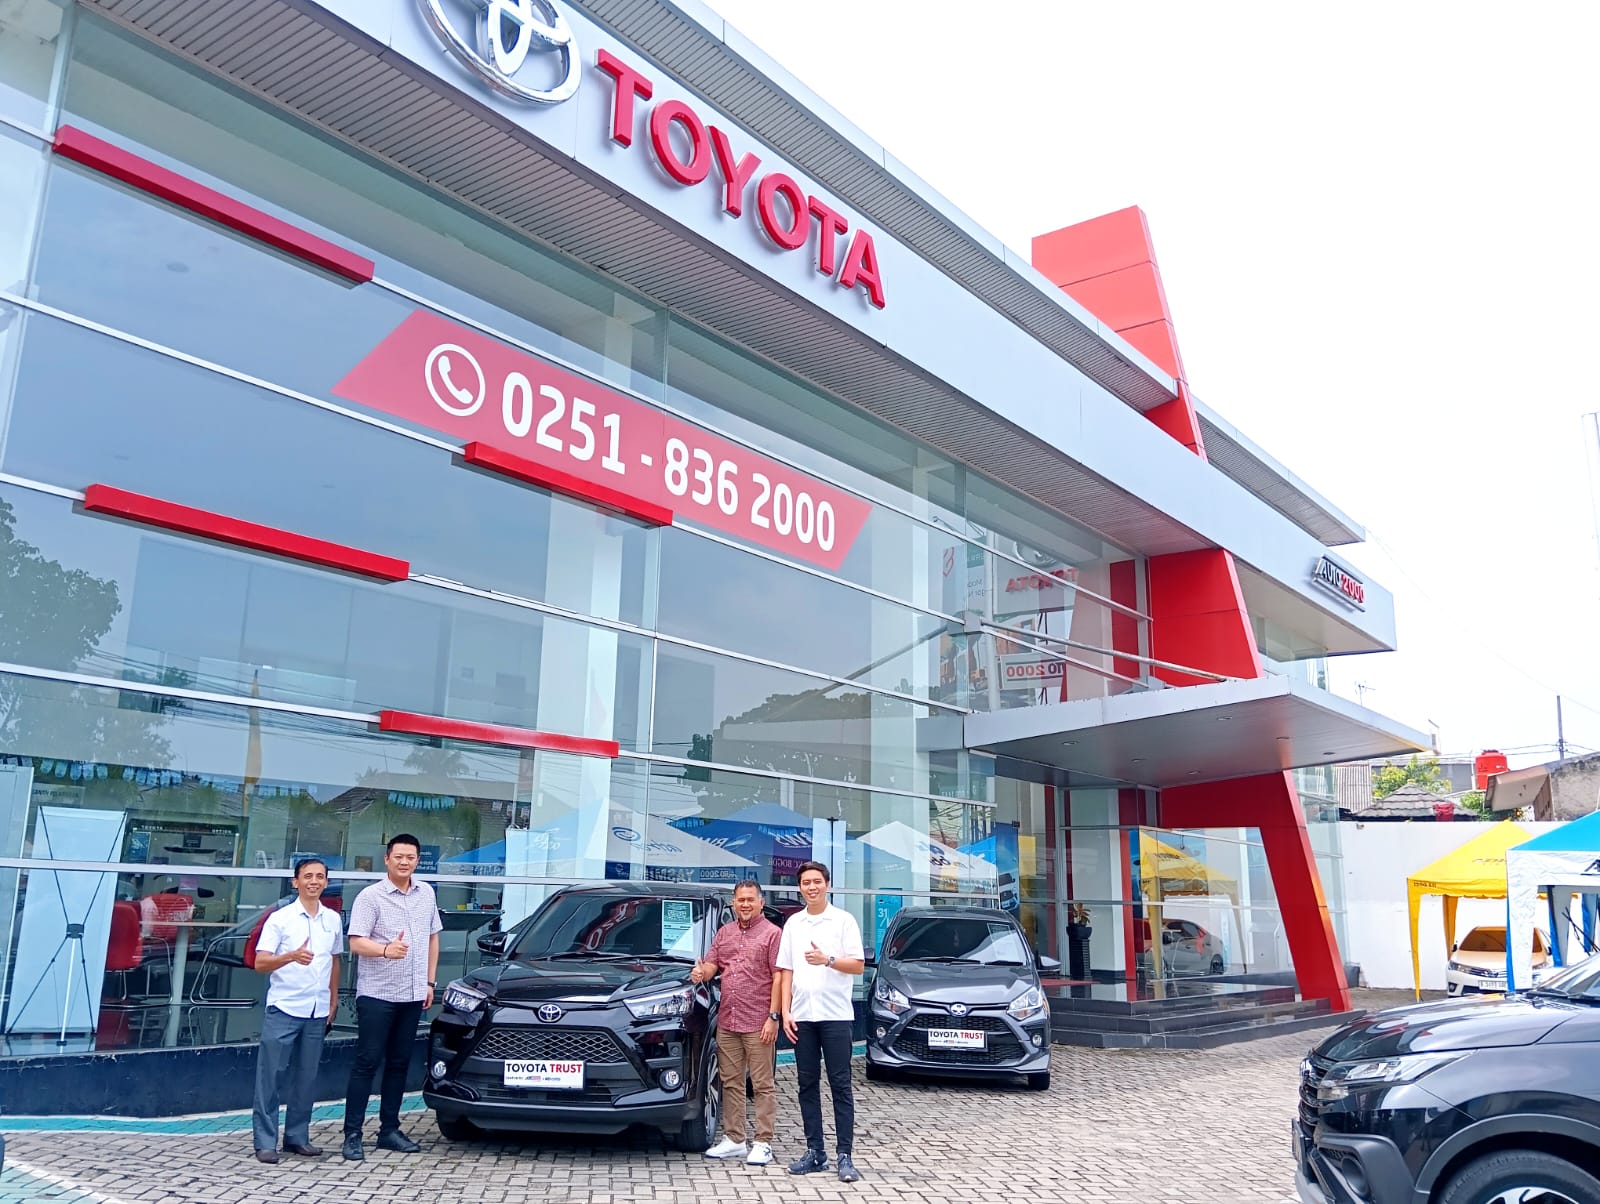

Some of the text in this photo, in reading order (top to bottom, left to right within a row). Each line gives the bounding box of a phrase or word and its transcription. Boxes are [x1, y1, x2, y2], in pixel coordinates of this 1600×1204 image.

[594, 48, 886, 310] TOYOTA
[502, 371, 626, 475] 0251
[664, 437, 738, 516] 836
[750, 472, 836, 552] 2000
[506, 1063, 583, 1073] TOYOTA TRUST
[929, 1031, 984, 1040] TOYOTA TRUST
